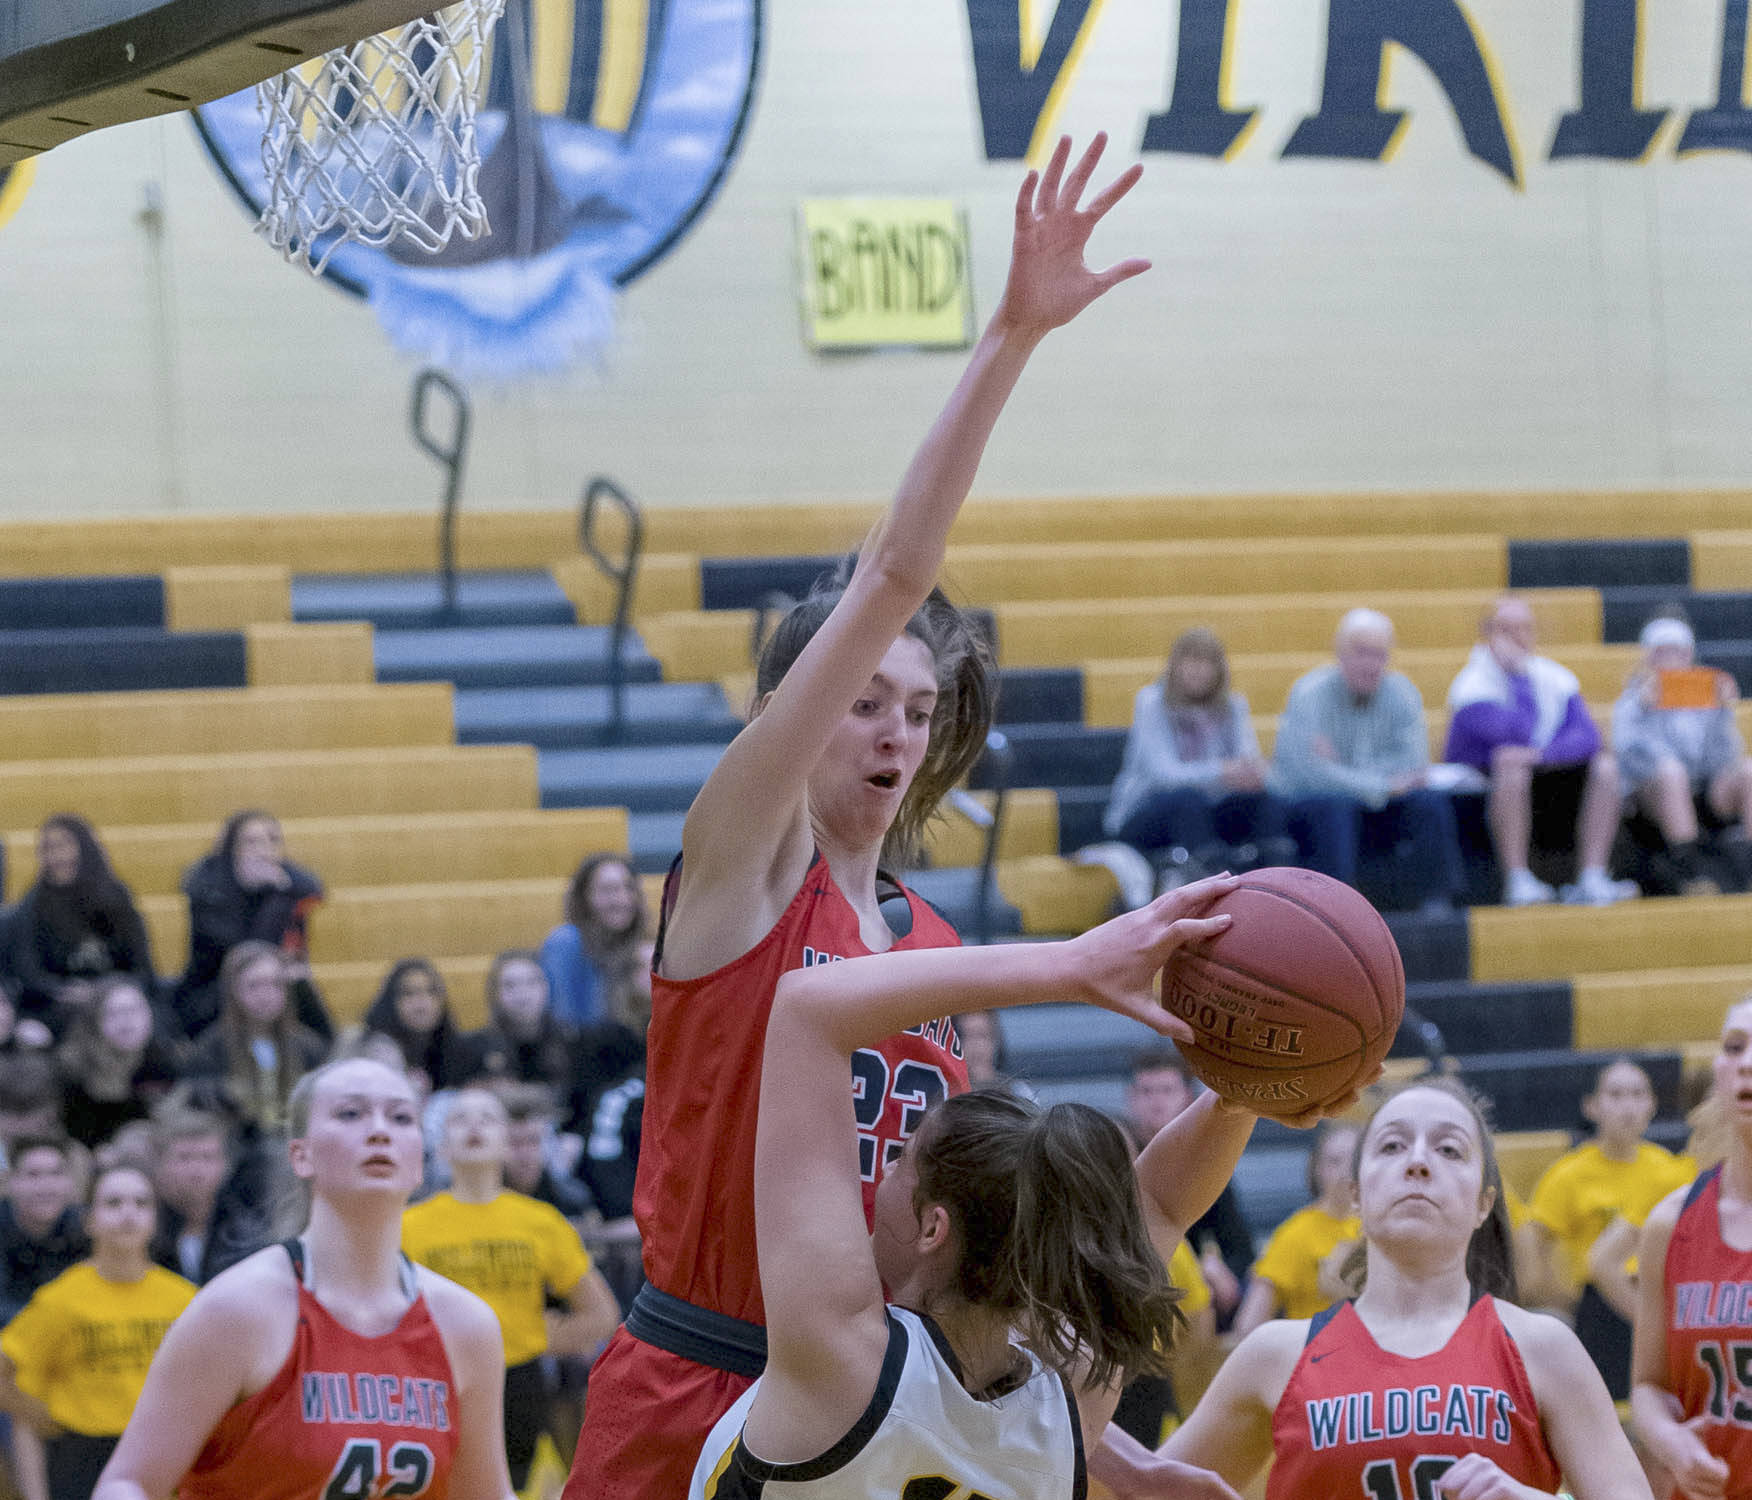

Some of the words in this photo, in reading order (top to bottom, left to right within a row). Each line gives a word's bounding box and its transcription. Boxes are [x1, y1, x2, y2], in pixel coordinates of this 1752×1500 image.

[814, 221, 963, 319] BAND
[303, 1371, 451, 1433] WILDCATS
[1305, 1384, 1517, 1451] WILDCATS
